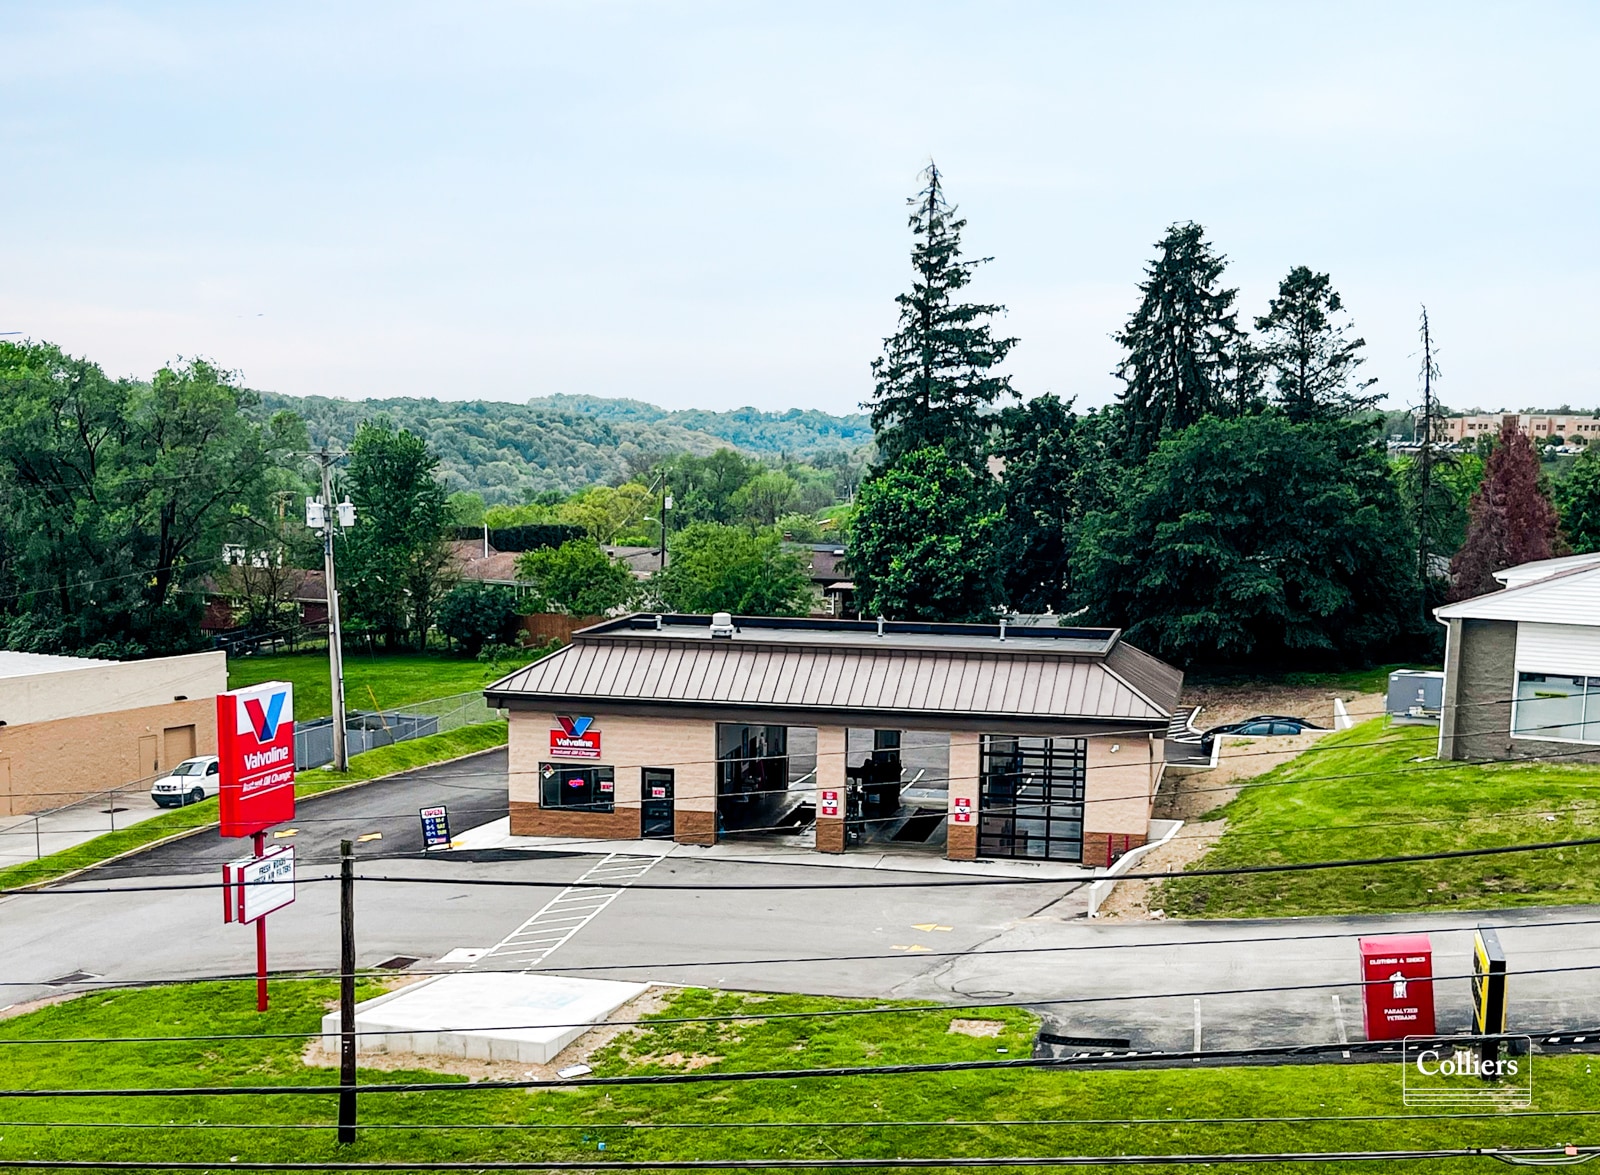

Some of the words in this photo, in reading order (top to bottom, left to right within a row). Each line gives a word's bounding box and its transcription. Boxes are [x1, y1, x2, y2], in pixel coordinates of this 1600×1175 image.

[556, 738, 593, 747] Valvoline
[244, 746, 288, 770] Valvoline
[271, 770, 292, 783] Change
[259, 864, 271, 875] FRESH
